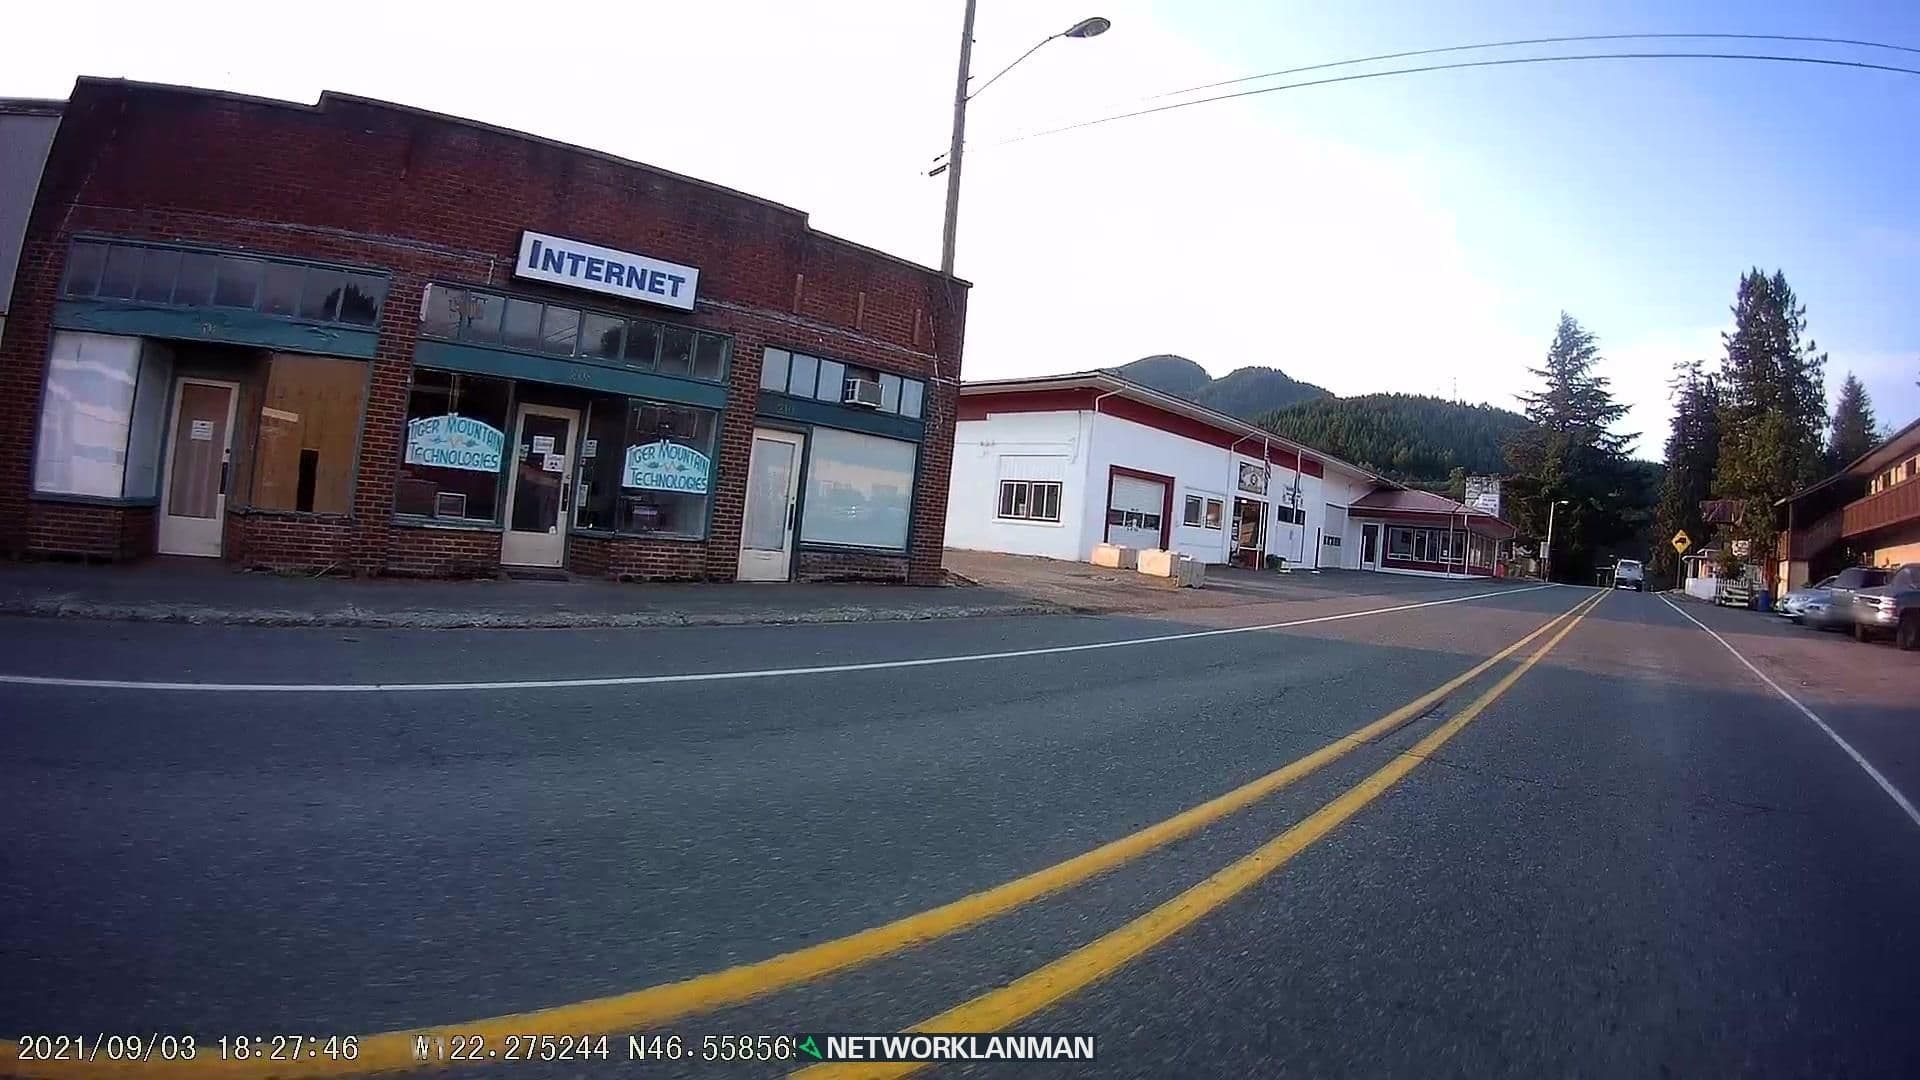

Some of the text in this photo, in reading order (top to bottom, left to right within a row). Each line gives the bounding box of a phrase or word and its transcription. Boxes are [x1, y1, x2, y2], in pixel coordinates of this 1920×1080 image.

[528, 239, 686, 297] INTERNET
[409, 419, 440, 440] TIGER
[447, 416, 503, 456] MOUNTAIN
[409, 441, 499, 469] TECHNOLOGIES
[659, 441, 709, 479] MOUNTAIN
[630, 467, 707, 492] TECHNOLOGIES
